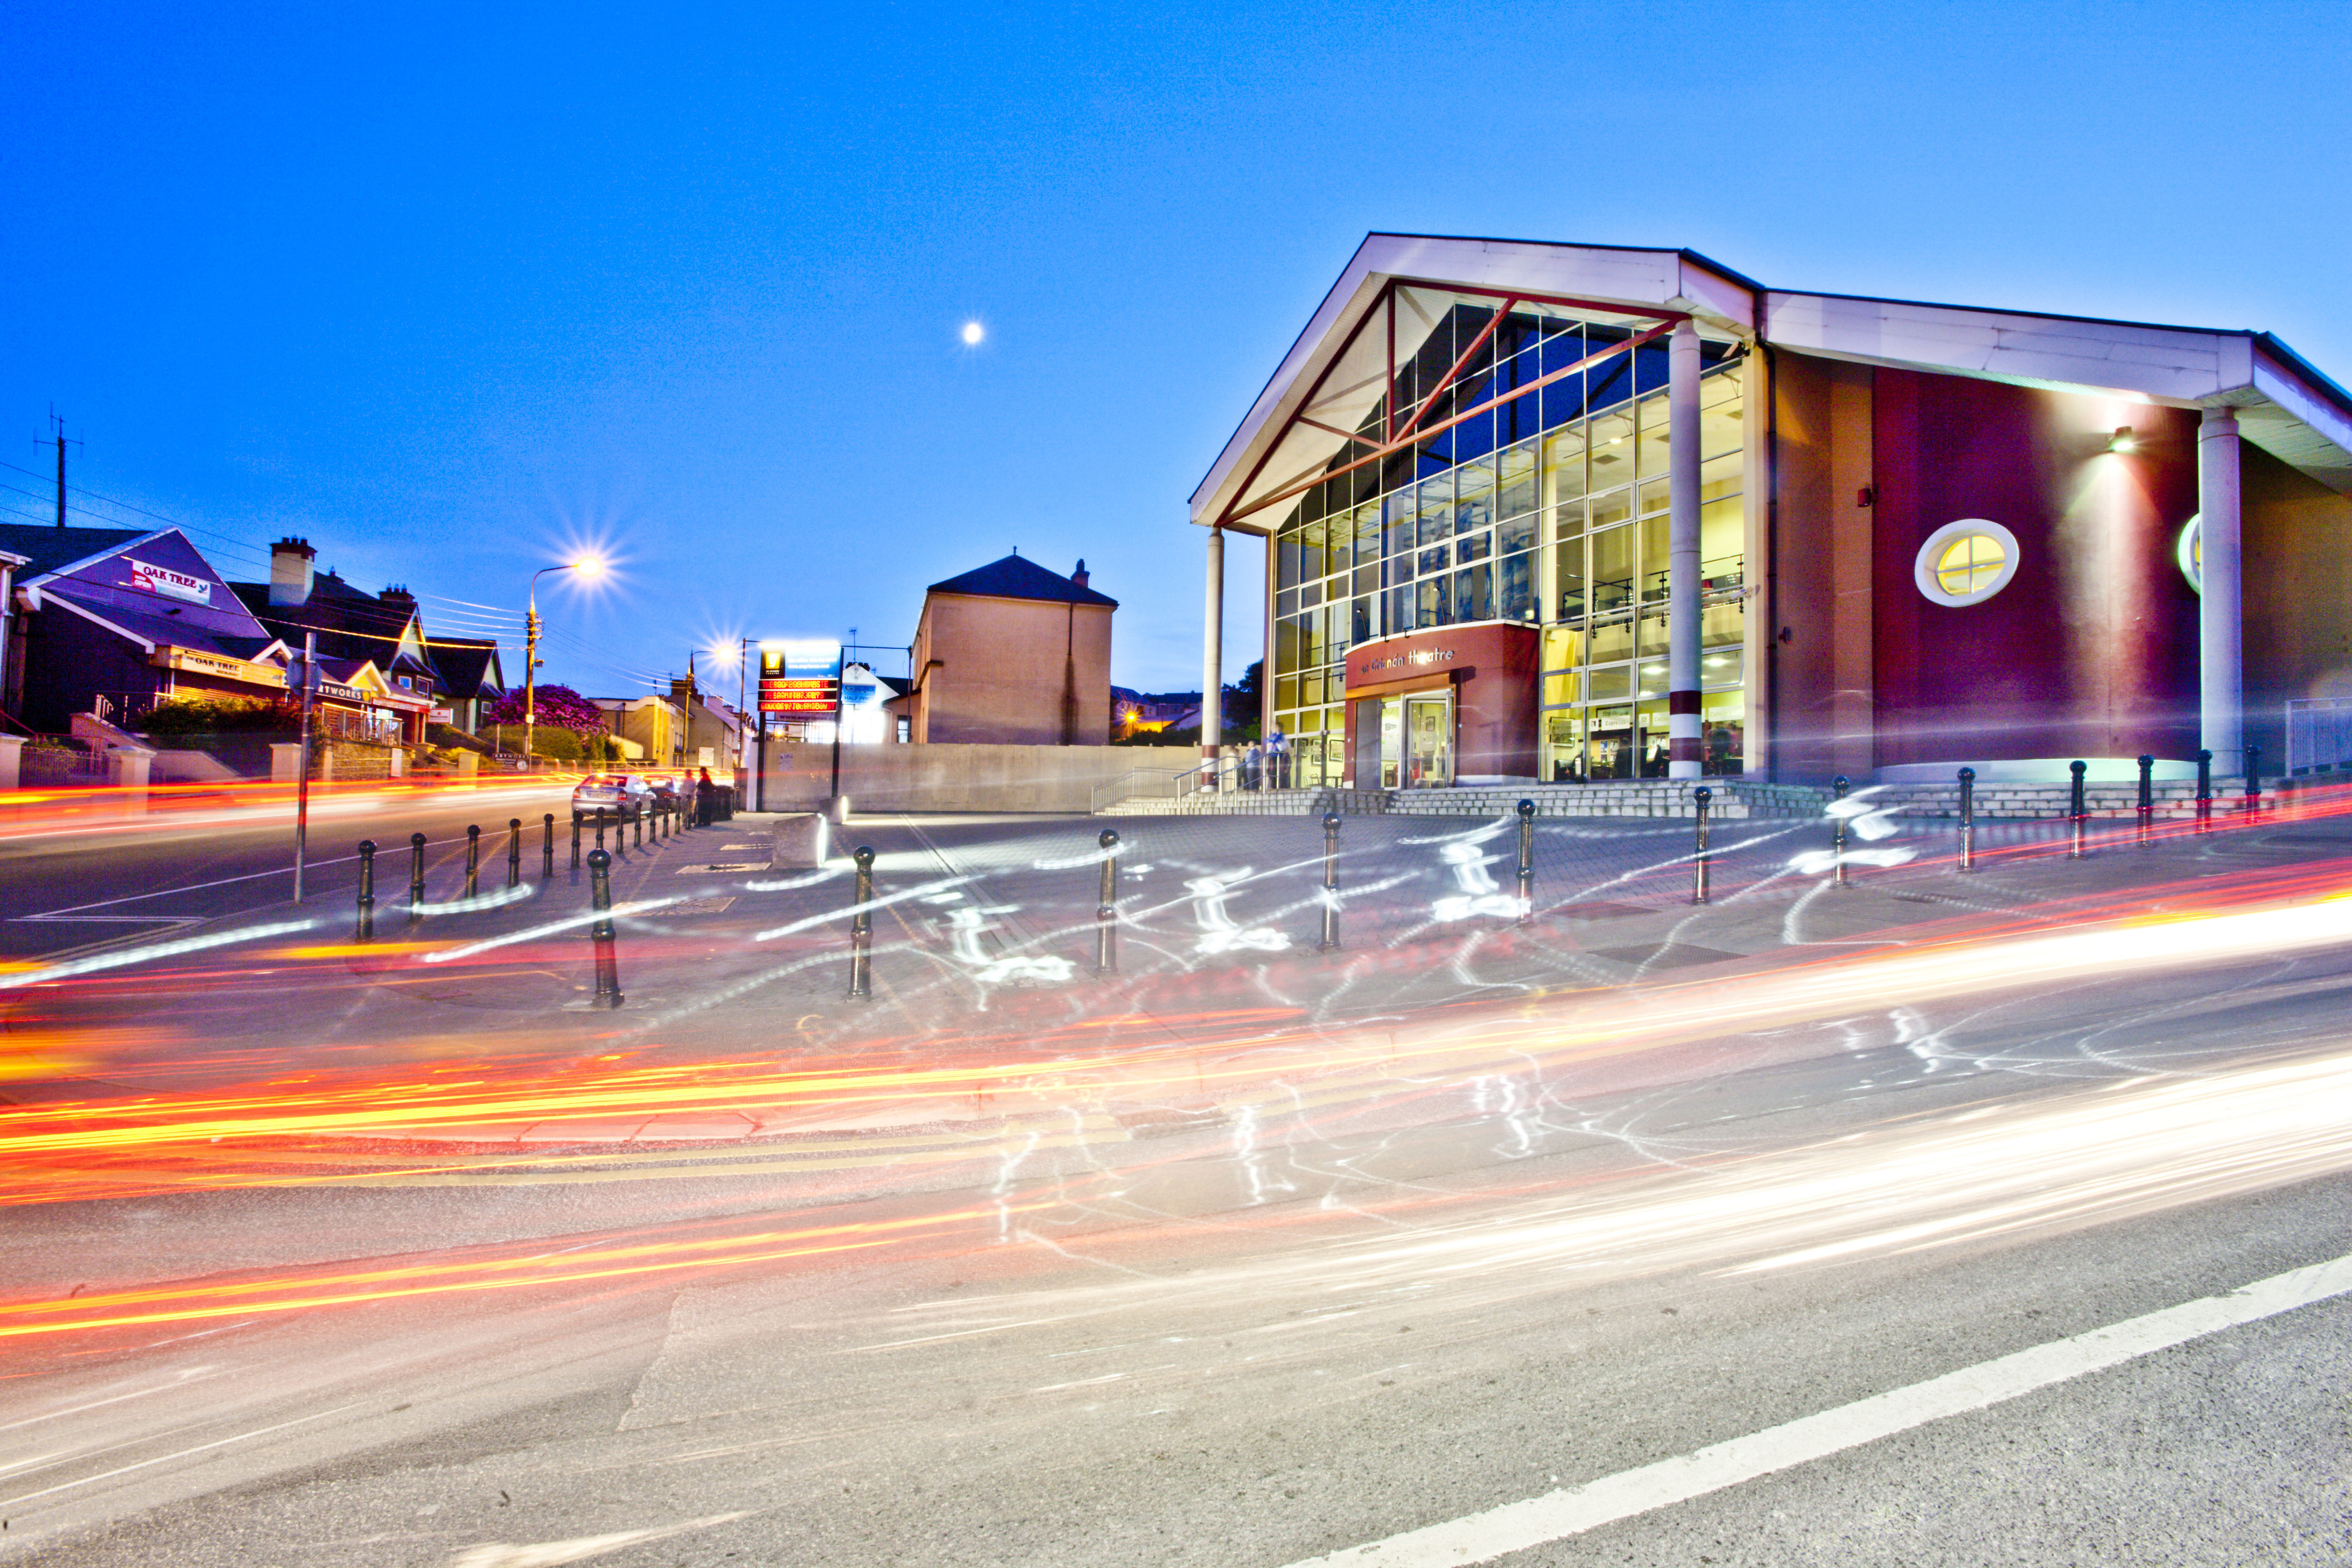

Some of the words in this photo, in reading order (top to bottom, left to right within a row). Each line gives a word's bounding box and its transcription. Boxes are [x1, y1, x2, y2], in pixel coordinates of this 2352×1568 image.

[143, 566, 167, 580] OAK
[169, 573, 197, 588] TREE
[195, 657, 214, 667] OAK
[216, 662, 240, 671] TREE
[318, 684, 361, 699] RTWORKS
